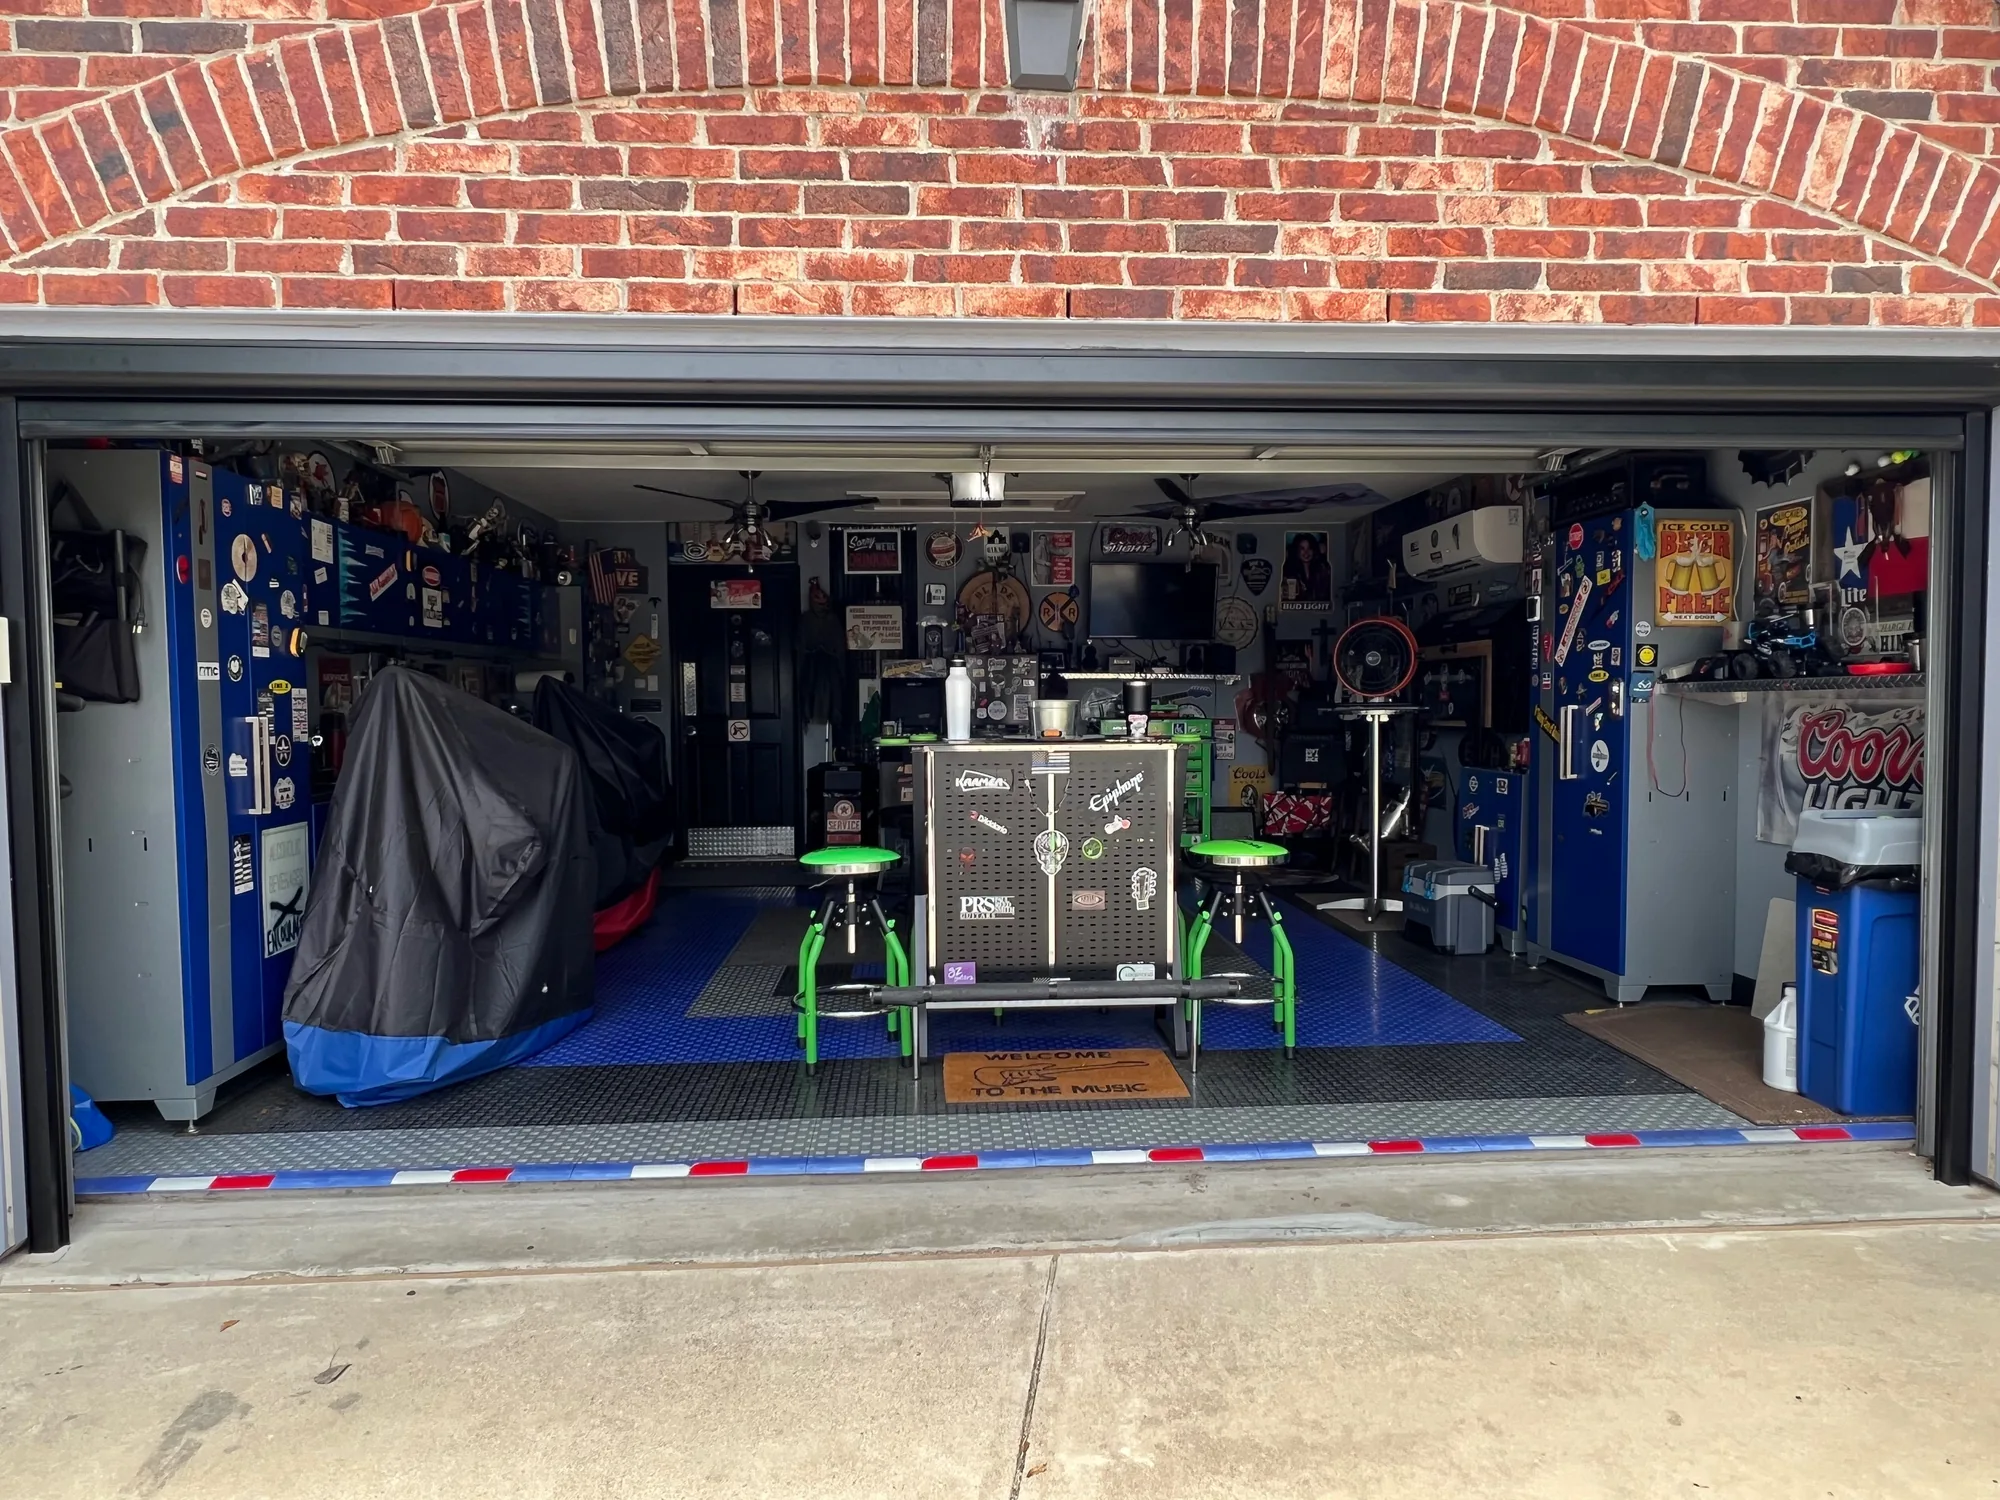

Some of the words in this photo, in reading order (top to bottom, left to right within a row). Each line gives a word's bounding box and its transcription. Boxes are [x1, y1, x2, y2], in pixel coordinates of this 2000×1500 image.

[1662, 523, 1685, 531] ICE
[1690, 523, 1729, 531] COLD
[848, 536, 875, 550] Sorry
[1660, 531, 1730, 560] BEER
[1659, 587, 1730, 613] FREE
[1841, 587, 1867, 608] Lite
[1043, 608, 1051, 616] R
[1068, 608, 1076, 616] R
[1233, 767, 1266, 779] Coors
[1088, 772, 1144, 812] Epiphone
[828, 820, 860, 830] SERVICE
[960, 896, 995, 914] PRS
[985, 1051, 1112, 1061] WELCOME
[970, 1086, 1005, 1097] TO
[1014, 1085, 1062, 1095] THE
[1071, 1083, 1148, 1094] MUSIC
